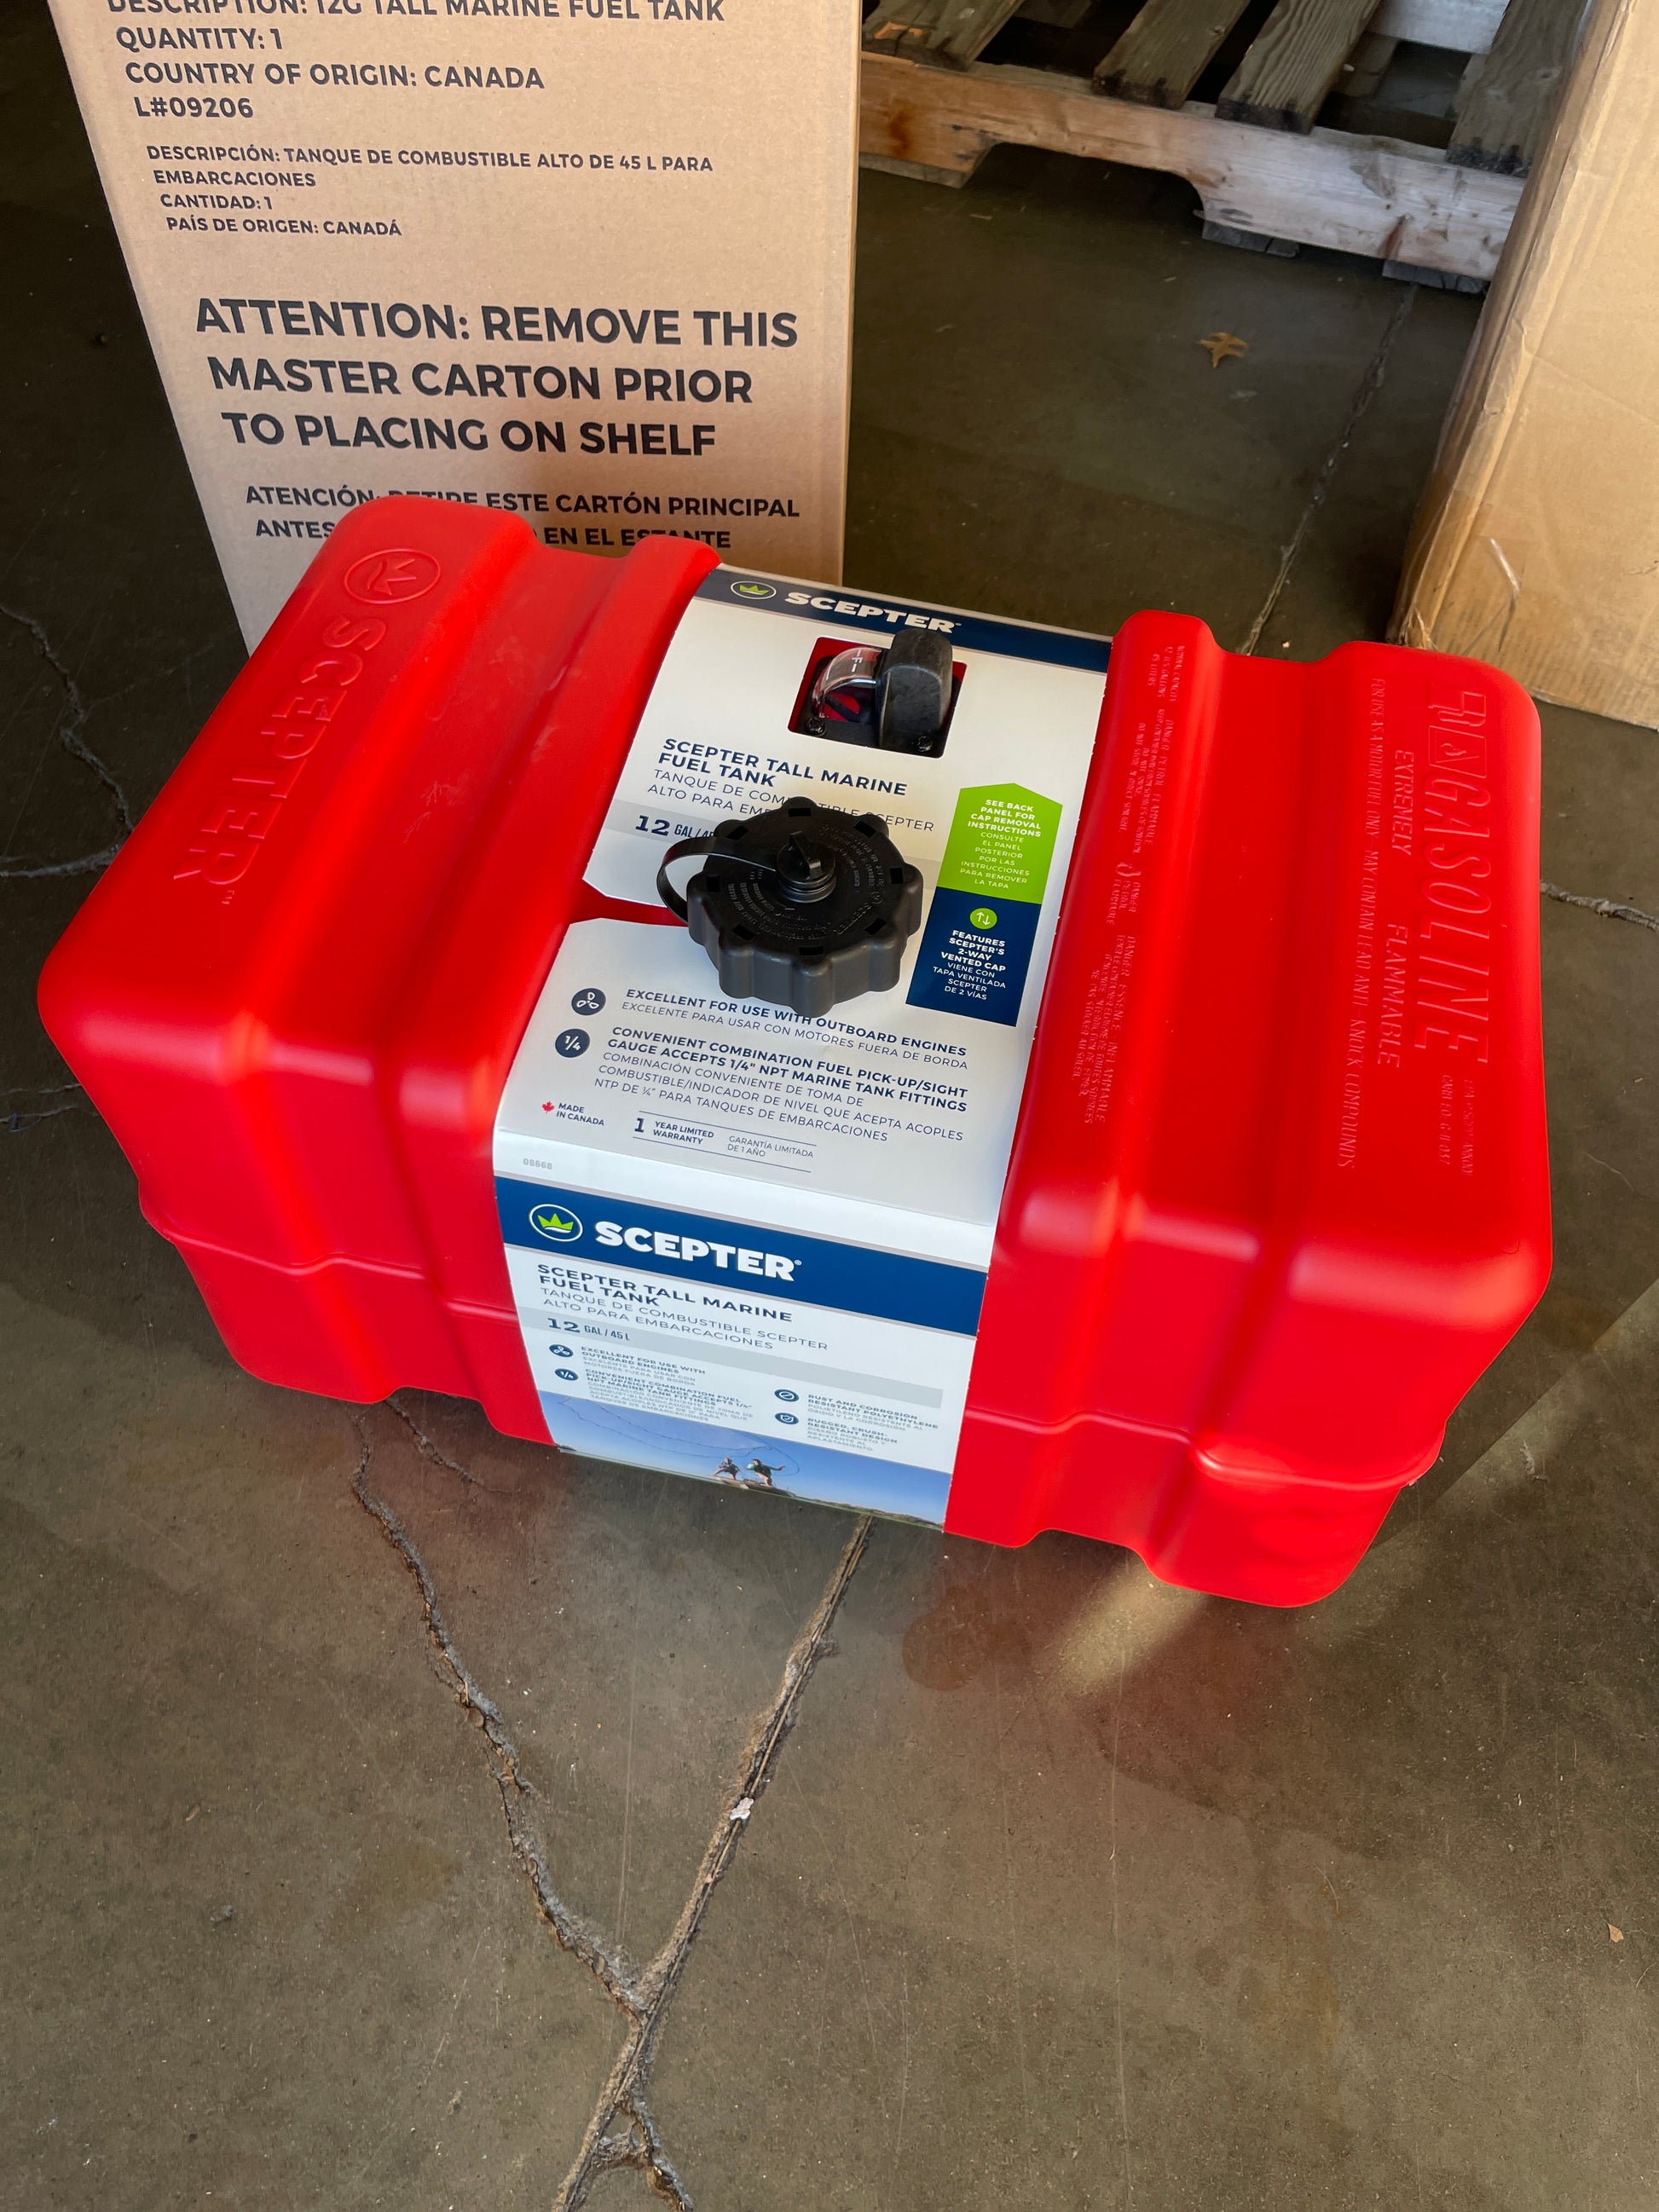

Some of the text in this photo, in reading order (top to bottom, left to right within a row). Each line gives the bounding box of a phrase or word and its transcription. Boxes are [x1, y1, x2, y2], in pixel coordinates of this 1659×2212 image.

[108, 0, 725, 21] DESCRIPTION: 12G TALL MARINE FUEL TANK
[116, 27, 282, 52] QUANTITY: 1
[125, 62, 545, 89] COUNTRY OF ORIGIN: CANADA
[134, 96, 254, 118] L#09206
[147, 144, 714, 172] DESCRIPCIÓN: TANQUE DE COMBUSTIBLE ALTO DE 45 L PARA
[153, 170, 316, 187] EMBARCACIONES
[159, 194, 273, 211] CANTIDAD: 1
[166, 216, 402, 236] PAÍS DE ORIGEN: CANADÁ
[195, 298, 798, 347] ATTENTION: REMOVE THIS
[207, 356, 753, 403] MASTER CARTON PRIOR
[221, 413, 715, 456] TO PLACING ON SHELF
[486, 493, 549, 511] ESTE
[556, 492, 661, 514] CARTÓN
[668, 498, 800, 517] PRINCIPAL
[256, 520, 335, 539] ANTES
[544, 528, 578, 545] EN
[585, 528, 615, 546] EL
[784, 591, 958, 634] SCEPTER
[659, 753, 777, 787] FUEL TANK
[663, 738, 907, 795] SCEPTER TALL MARINE
[654, 769, 743, 797] TANQUE DE
[648, 784, 733, 811] ALTO PARA
[1007, 803, 1033, 811] BACK
[1390, 749, 1415, 857] EXTREMELY
[980, 806, 1012, 817] PANEL
[993, 817, 1041, 829] REMOVAL
[635, 815, 695, 838] 12 GAL
[968, 821, 1041, 837] INSTRUCTIONS
[1414, 774, 1492, 1065] GASOLINE
[949, 938, 1005, 955] SCEPTER'S
[952, 930, 1006, 947] FEATURES
[941, 951, 1006, 972] VENTED CAP
[958, 948, 991, 961] 2-WAY
[933, 966, 1006, 988] TAPA VENTILADA
[948, 962, 995, 978] VIENE CON
[948, 979, 987, 992] SCEPTER
[967, 990, 987, 1000] VÍAS
[1377, 922, 1409, 1069] FLAMMABLE
[627, 989, 968, 1057] EXCELLENT FOR USE WITH OUTBOARD ENGINES
[621, 1002, 968, 1070] EXCELENTE PARA USAR CON MOTORES FUERA DE BORDA
[612, 1026, 968, 1099] CONVENIENT COMBINATION FUEL PICK-UP/SIGHT
[603, 1052, 864, 1107] COMBINACIÓN CONVENIENTE DE TOMA DE
[608, 1039, 968, 1112] GAUGE ACCEPTS 1/4" NPT MARINE TANK FITTINGS
[558, 1102, 585, 1113] MADE
[594, 1078, 888, 1141] NTP DE PARA TANQUES DE EMBARCACIONES
[598, 1065, 963, 1141] COMBUSTIBLE/INDICADOR DE NIVEL QUE ACEPTA ACOPLES
[567, 1112, 605, 1126] CANADA
[634, 1118, 714, 1139] 1 YEAR LIMITED
[652, 1129, 703, 1145] WARRANTY
[729, 1135, 814, 1158] GARANTÍA LIMITADA
[538, 1264, 793, 1322] SCEPTER TALL MARINE
[540, 1275, 661, 1307] FUEL TANK
[540, 1287, 828, 1350] TANQUE DE COMBUSTIBLE SCEPTER
[544, 1299, 774, 1349] ALTO PARA EMBARCACIONES
[547, 1318, 624, 1340] 12 GAL 45
